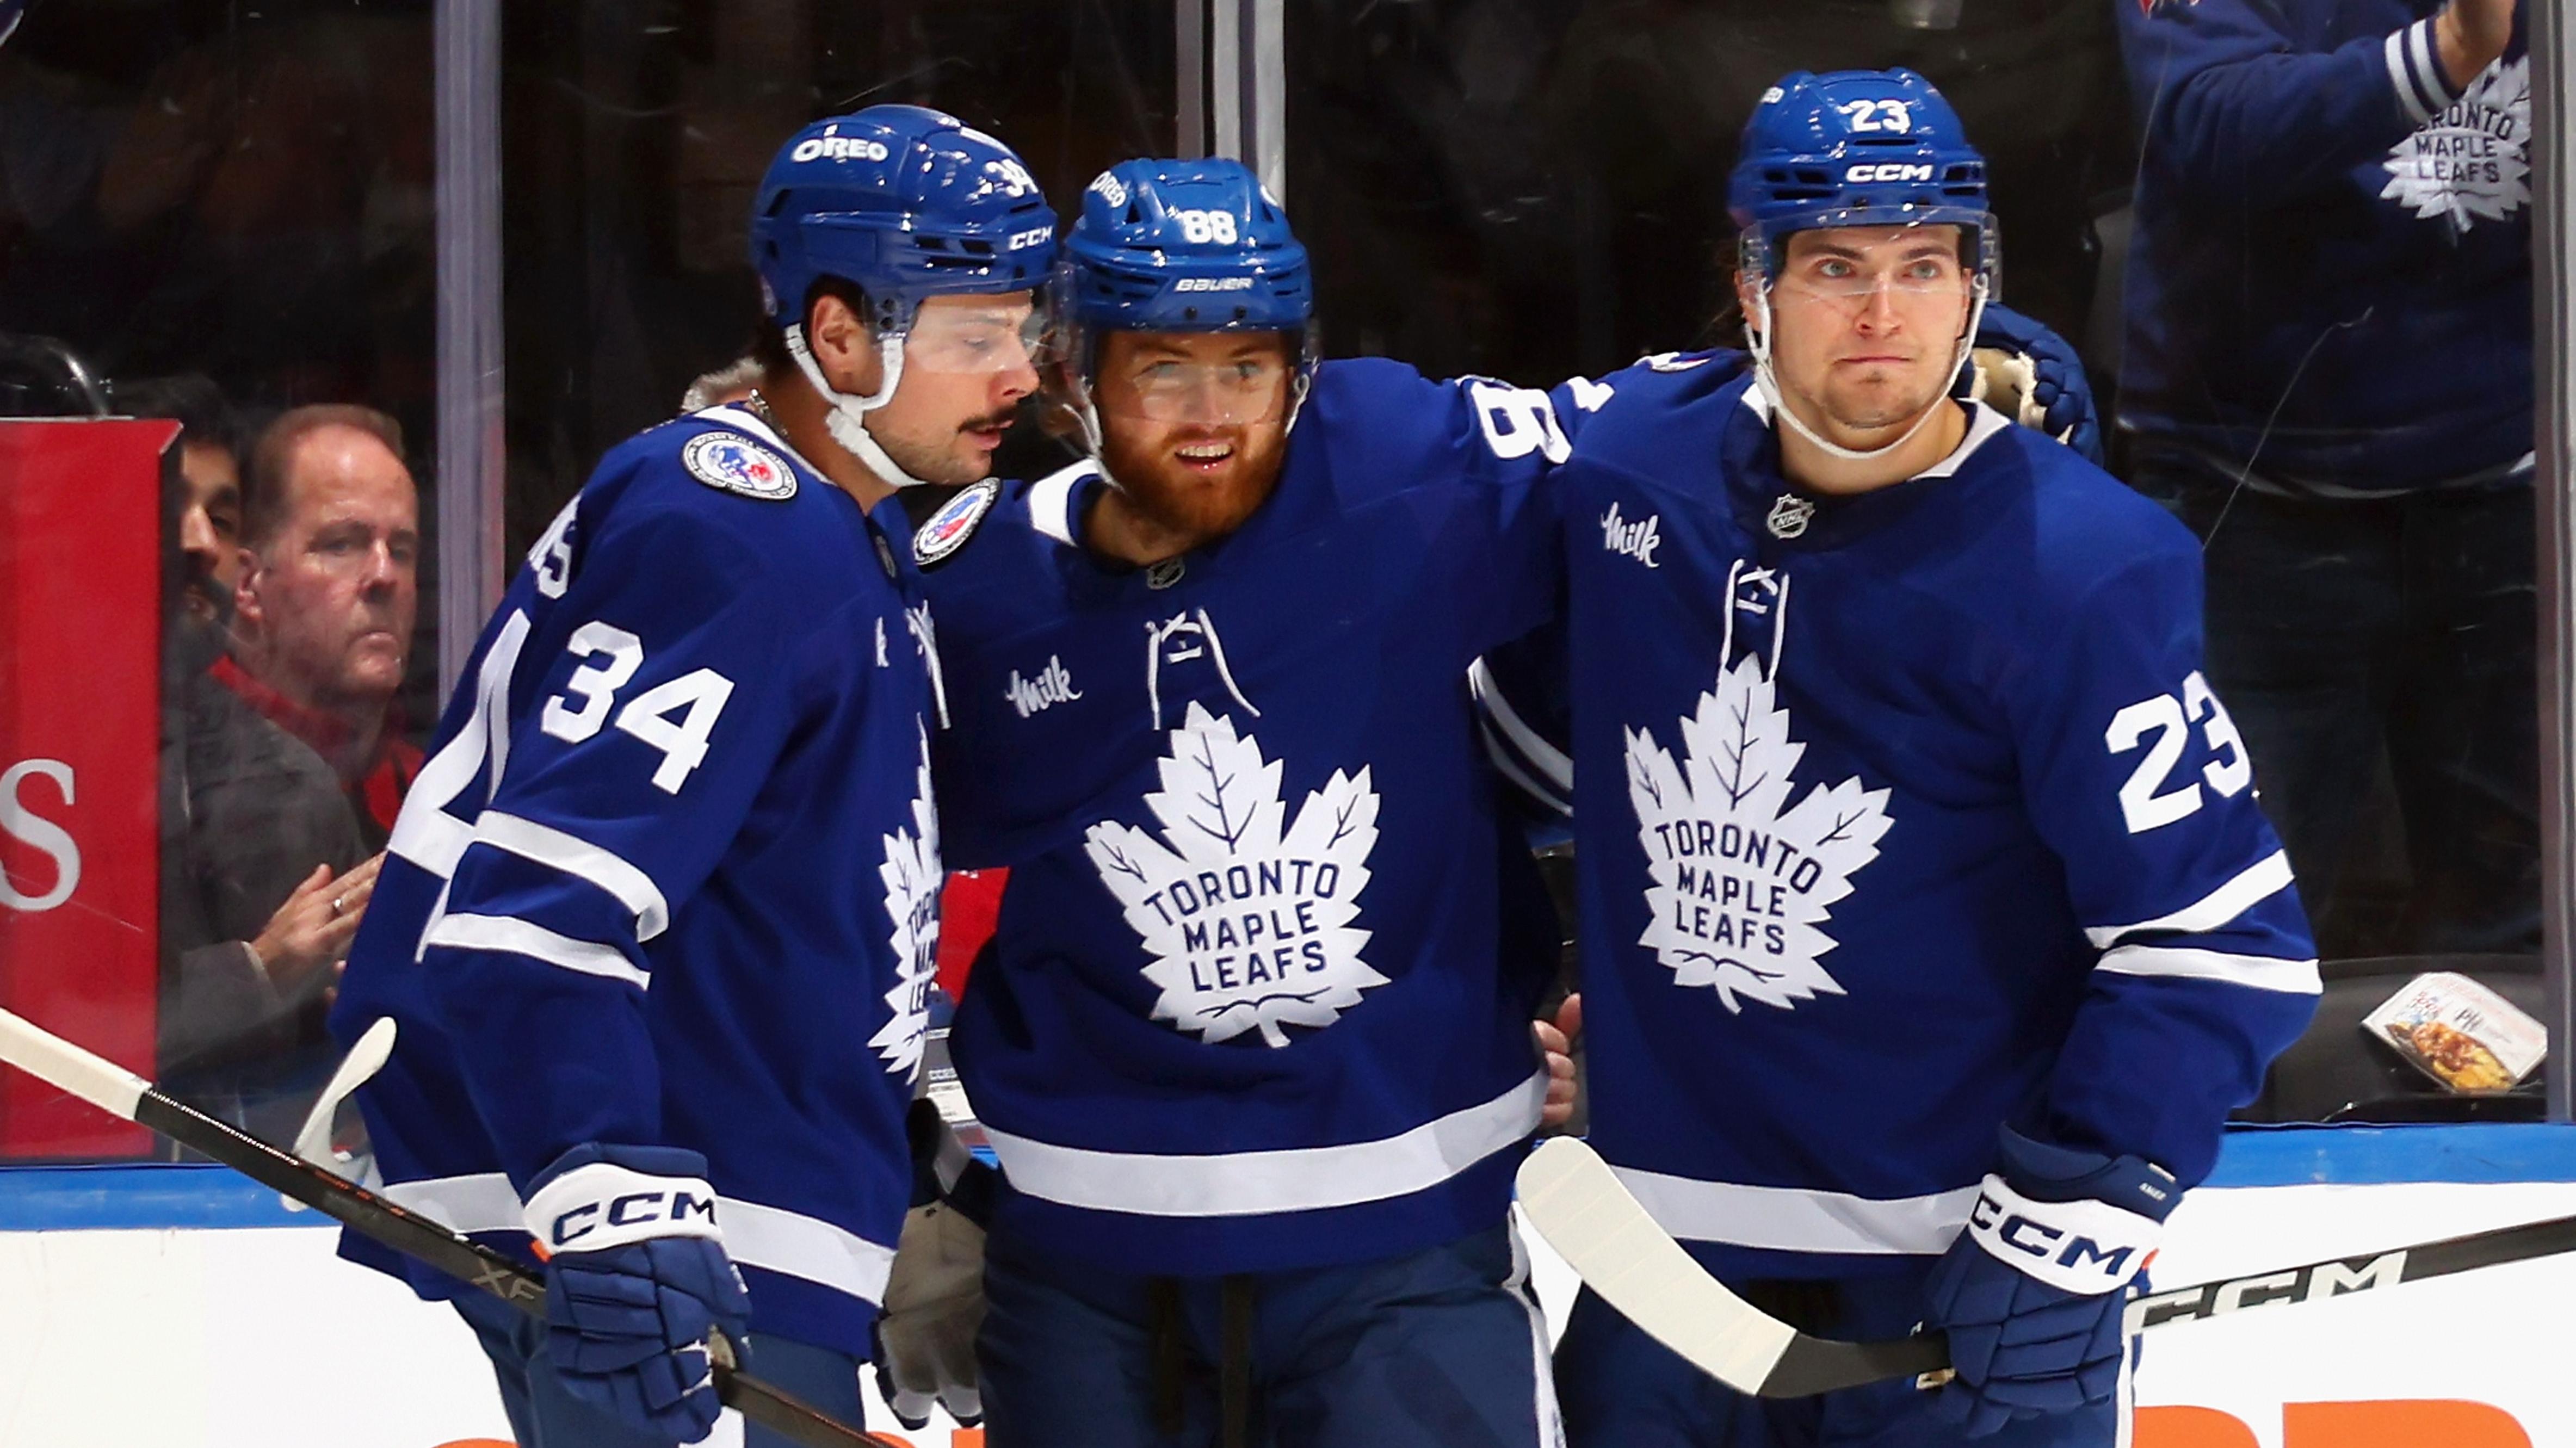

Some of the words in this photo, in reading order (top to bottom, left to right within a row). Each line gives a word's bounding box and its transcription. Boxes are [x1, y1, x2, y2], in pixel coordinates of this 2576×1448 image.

[1849, 100, 1912, 134] 23
[2414, 102, 2514, 141] RONTO
[791, 136, 889, 163] OREO
[1846, 164, 1933, 183] CCM
[2416, 137, 2498, 157] MAPLE
[2419, 161, 2500, 183] LEAFS
[985, 158, 1039, 197] 34
[1088, 170, 1126, 208] OREO
[1008, 226, 1053, 251] CCM
[1181, 210, 1238, 246] 88
[1174, 277, 1255, 292] BAUER
[1600, 501, 1661, 568] Milk
[541, 620, 735, 795] 34
[1005, 653, 1083, 719] Milk
[2104, 669, 2252, 834] 23
[1655, 819, 1823, 895] TORONTO
[1143, 859, 1340, 926] TORONTO
[1677, 862, 1787, 918] MAPLE
[1182, 900, 1320, 953] MAPLE
[1675, 899, 1786, 956] LEAFS
[1190, 940, 1328, 993] LEAFS
[552, 1191, 717, 1246] CCM
[1970, 1191, 2137, 1277] CCM
[2123, 1250, 2408, 1337] CCM
